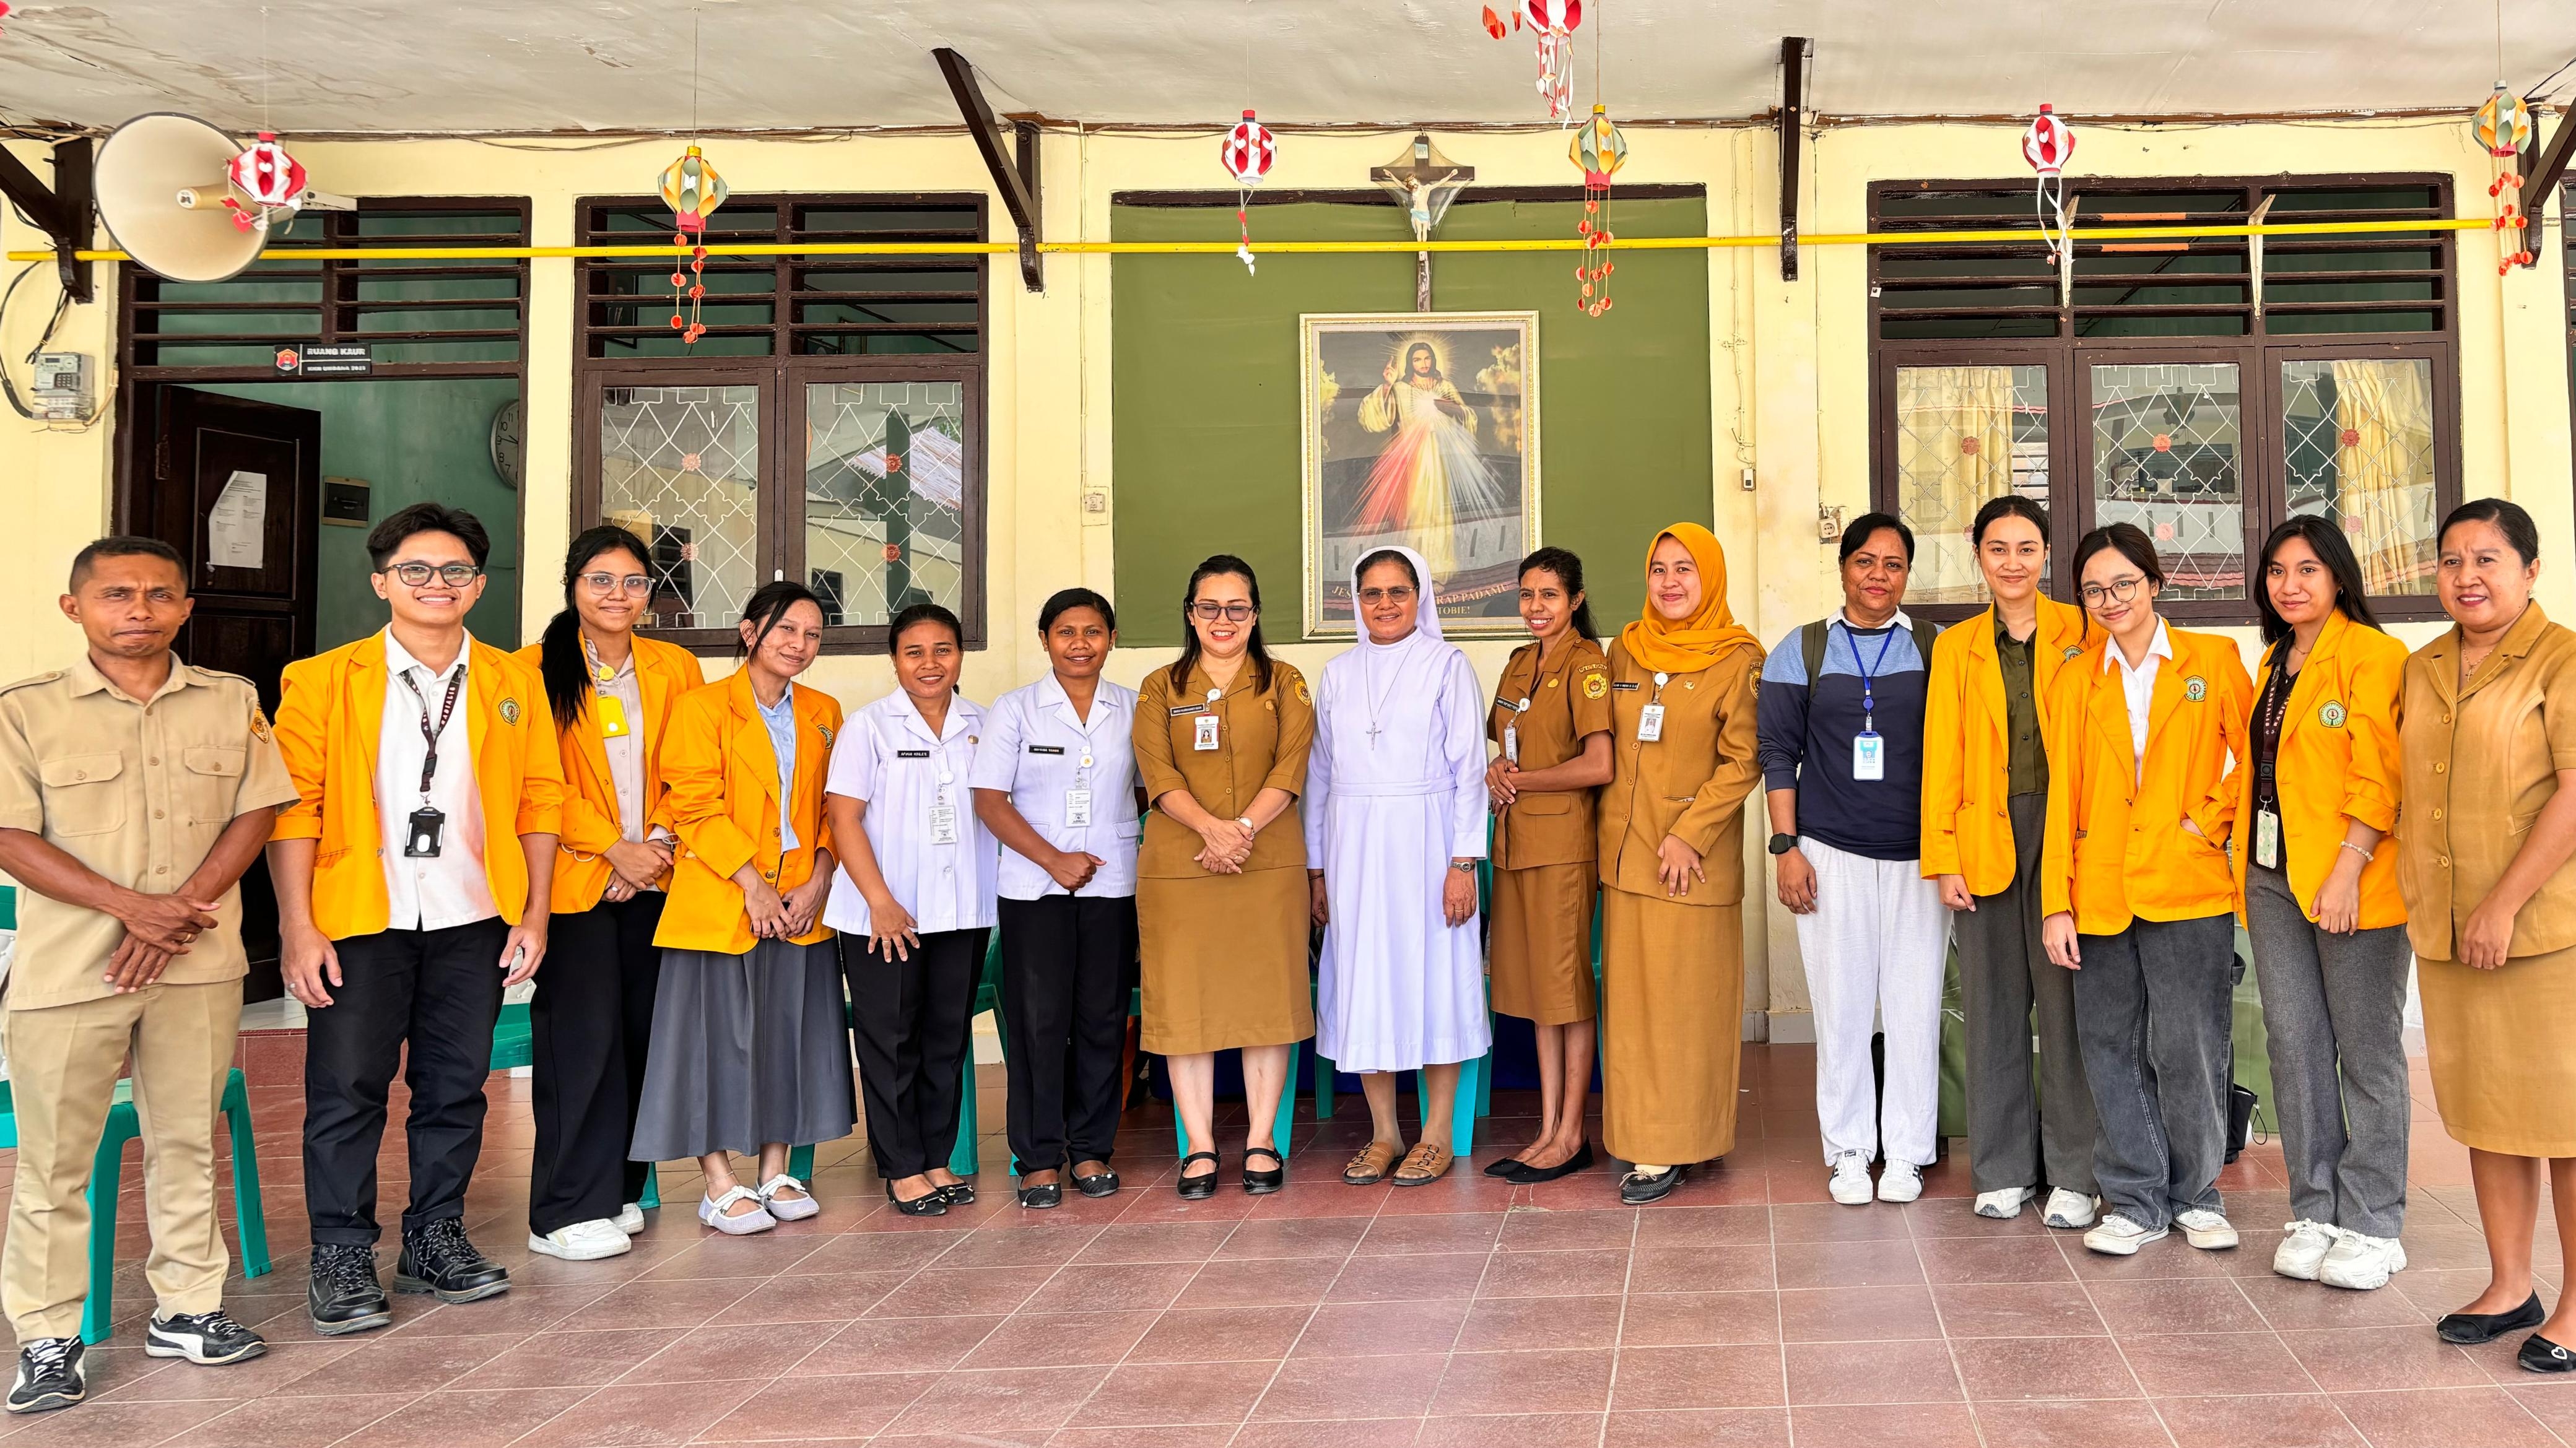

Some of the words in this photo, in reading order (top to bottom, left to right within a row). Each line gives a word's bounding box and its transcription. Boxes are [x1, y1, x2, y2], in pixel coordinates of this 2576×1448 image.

[499, 452, 505, 463] 8
[505, 464, 511, 474] 7
[1332, 586, 1352, 599] JES
[1461, 584, 1509, 602] PADAMU
